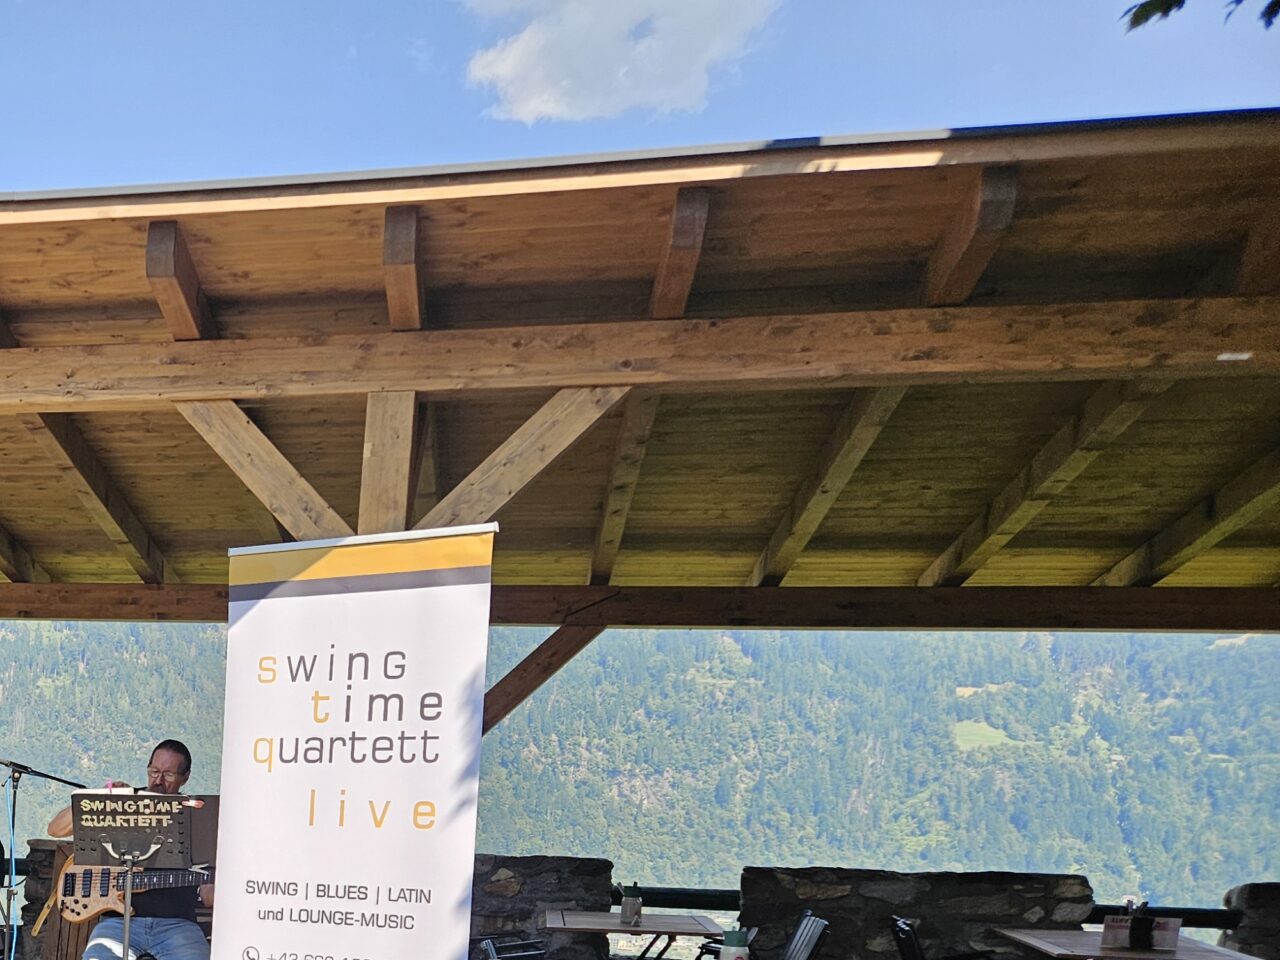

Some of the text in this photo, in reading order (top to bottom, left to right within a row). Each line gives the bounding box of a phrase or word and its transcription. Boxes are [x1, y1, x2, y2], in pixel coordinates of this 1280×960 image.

[311, 684, 443, 724] time
[253, 730, 440, 773] quartett
[80, 799, 183, 814] SWINGTIME
[308, 789, 437, 830] live
[80, 815, 173, 828] QUARTETT
[245, 880, 299, 896] SWING
[316, 884, 369, 901] BLUES
[388, 887, 432, 904] LATIN
[258, 907, 415, 930] und LOUNGE-MUSIC
